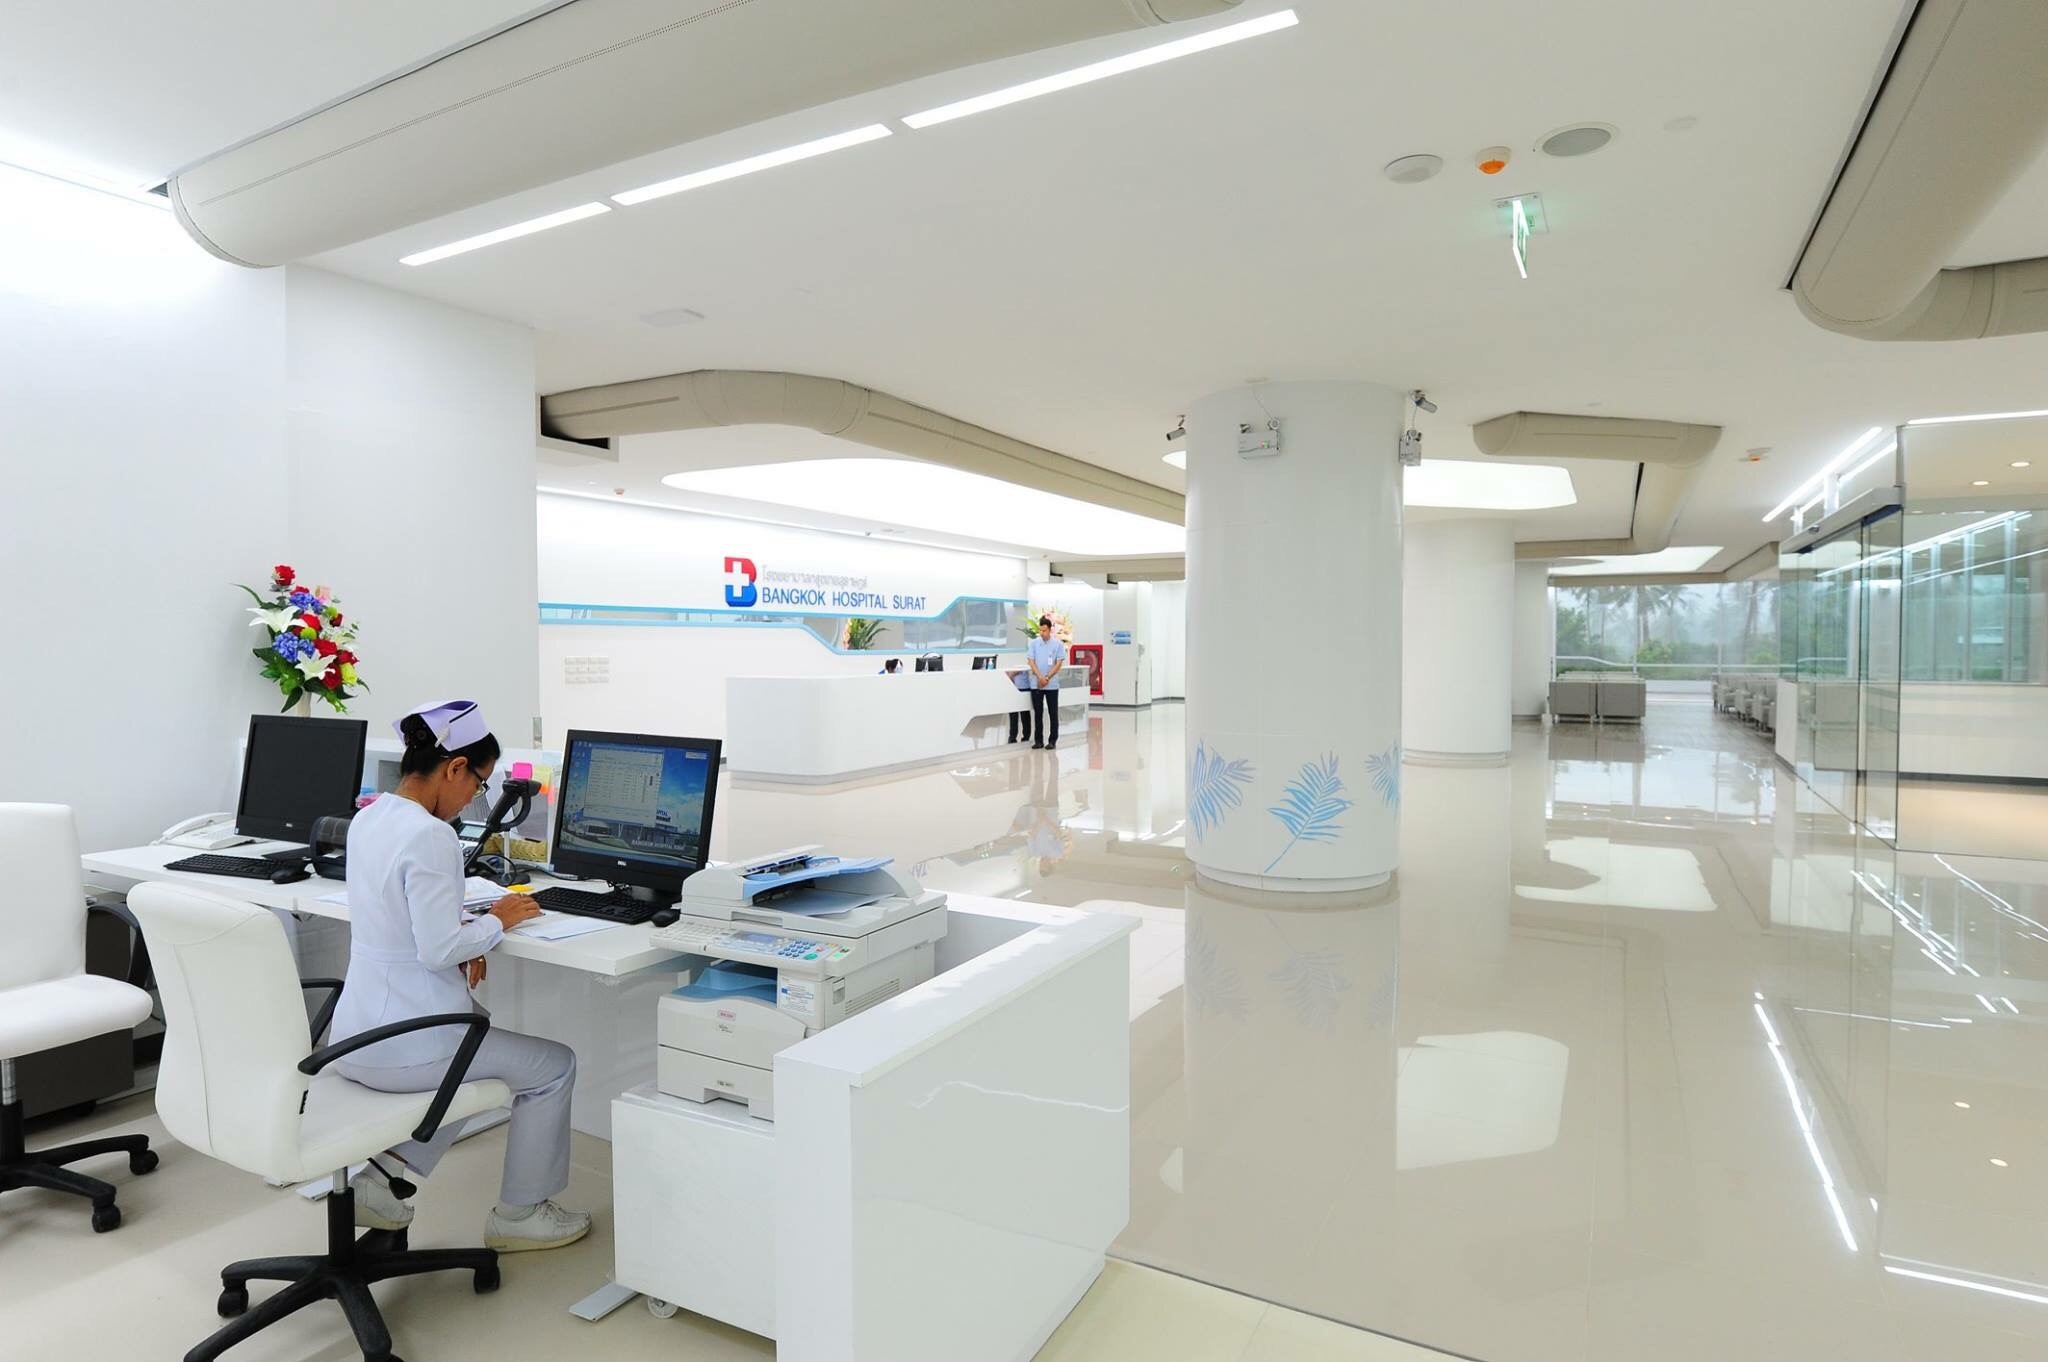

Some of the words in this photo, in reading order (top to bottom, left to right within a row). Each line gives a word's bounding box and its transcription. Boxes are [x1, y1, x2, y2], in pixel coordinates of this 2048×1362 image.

[762, 587, 826, 606] BANGKOK
[832, 591, 888, 609] HOSPITAL
[892, 596, 926, 610] SURAT
